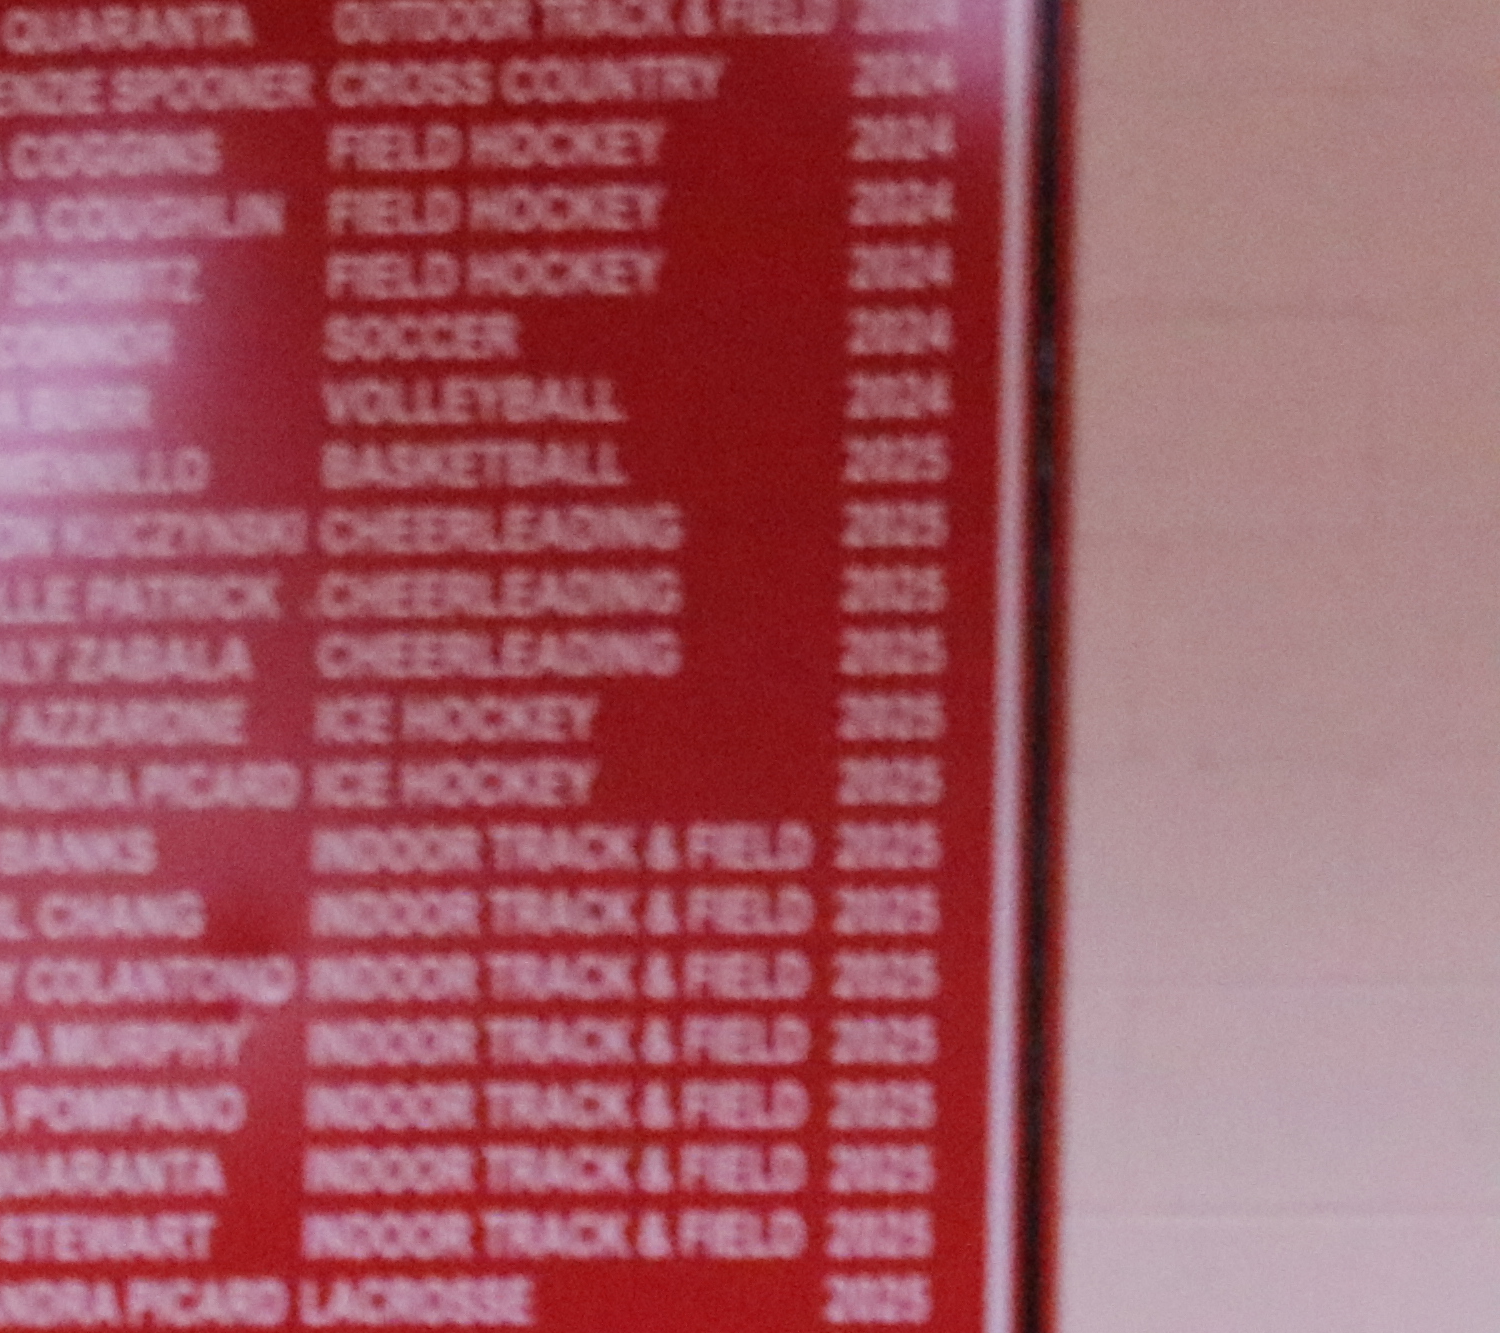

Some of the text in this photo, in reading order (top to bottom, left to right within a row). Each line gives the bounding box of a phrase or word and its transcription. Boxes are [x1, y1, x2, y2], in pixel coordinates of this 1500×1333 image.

[329, 55, 723, 107] CROSS COUNTRY
[328, 120, 665, 171] FIELD HOCKEY
[323, 312, 518, 362] SOCCER
